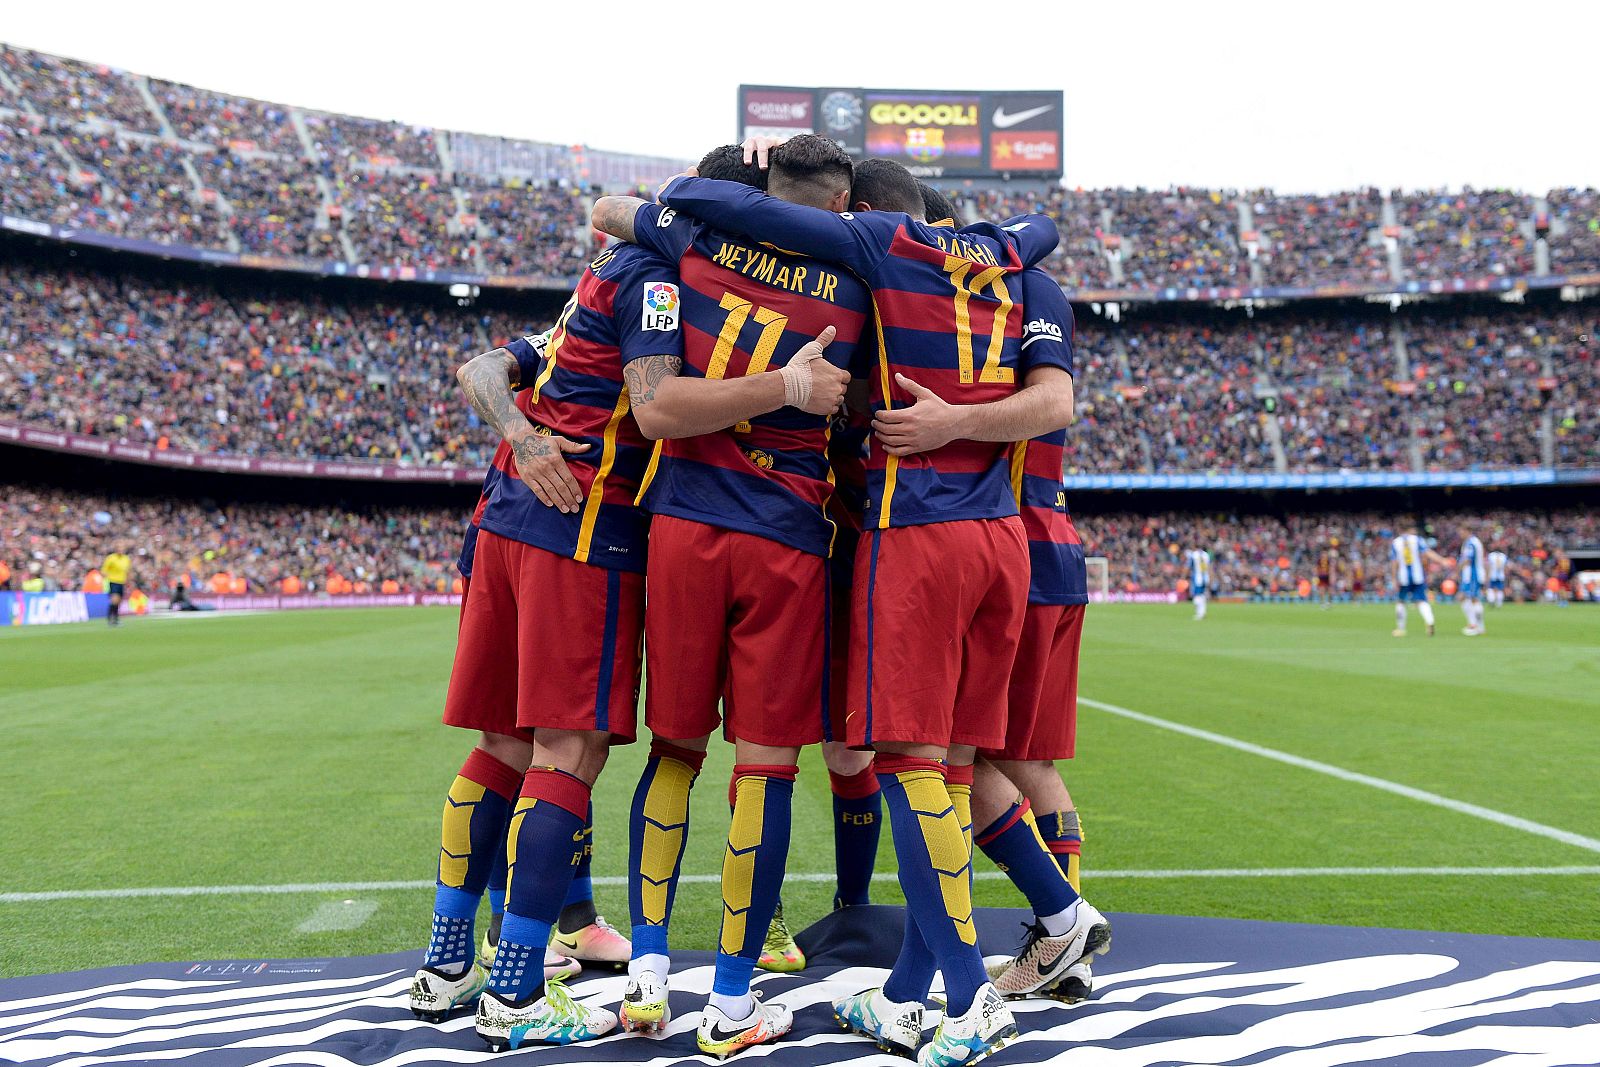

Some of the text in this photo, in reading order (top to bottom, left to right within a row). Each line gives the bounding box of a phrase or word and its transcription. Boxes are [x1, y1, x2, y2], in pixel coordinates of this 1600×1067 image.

[713, 242, 838, 302] NEYMAR JR
[646, 314, 674, 330] LFP
[842, 811, 874, 825] FCB
[896, 1018, 922, 1034] adida
